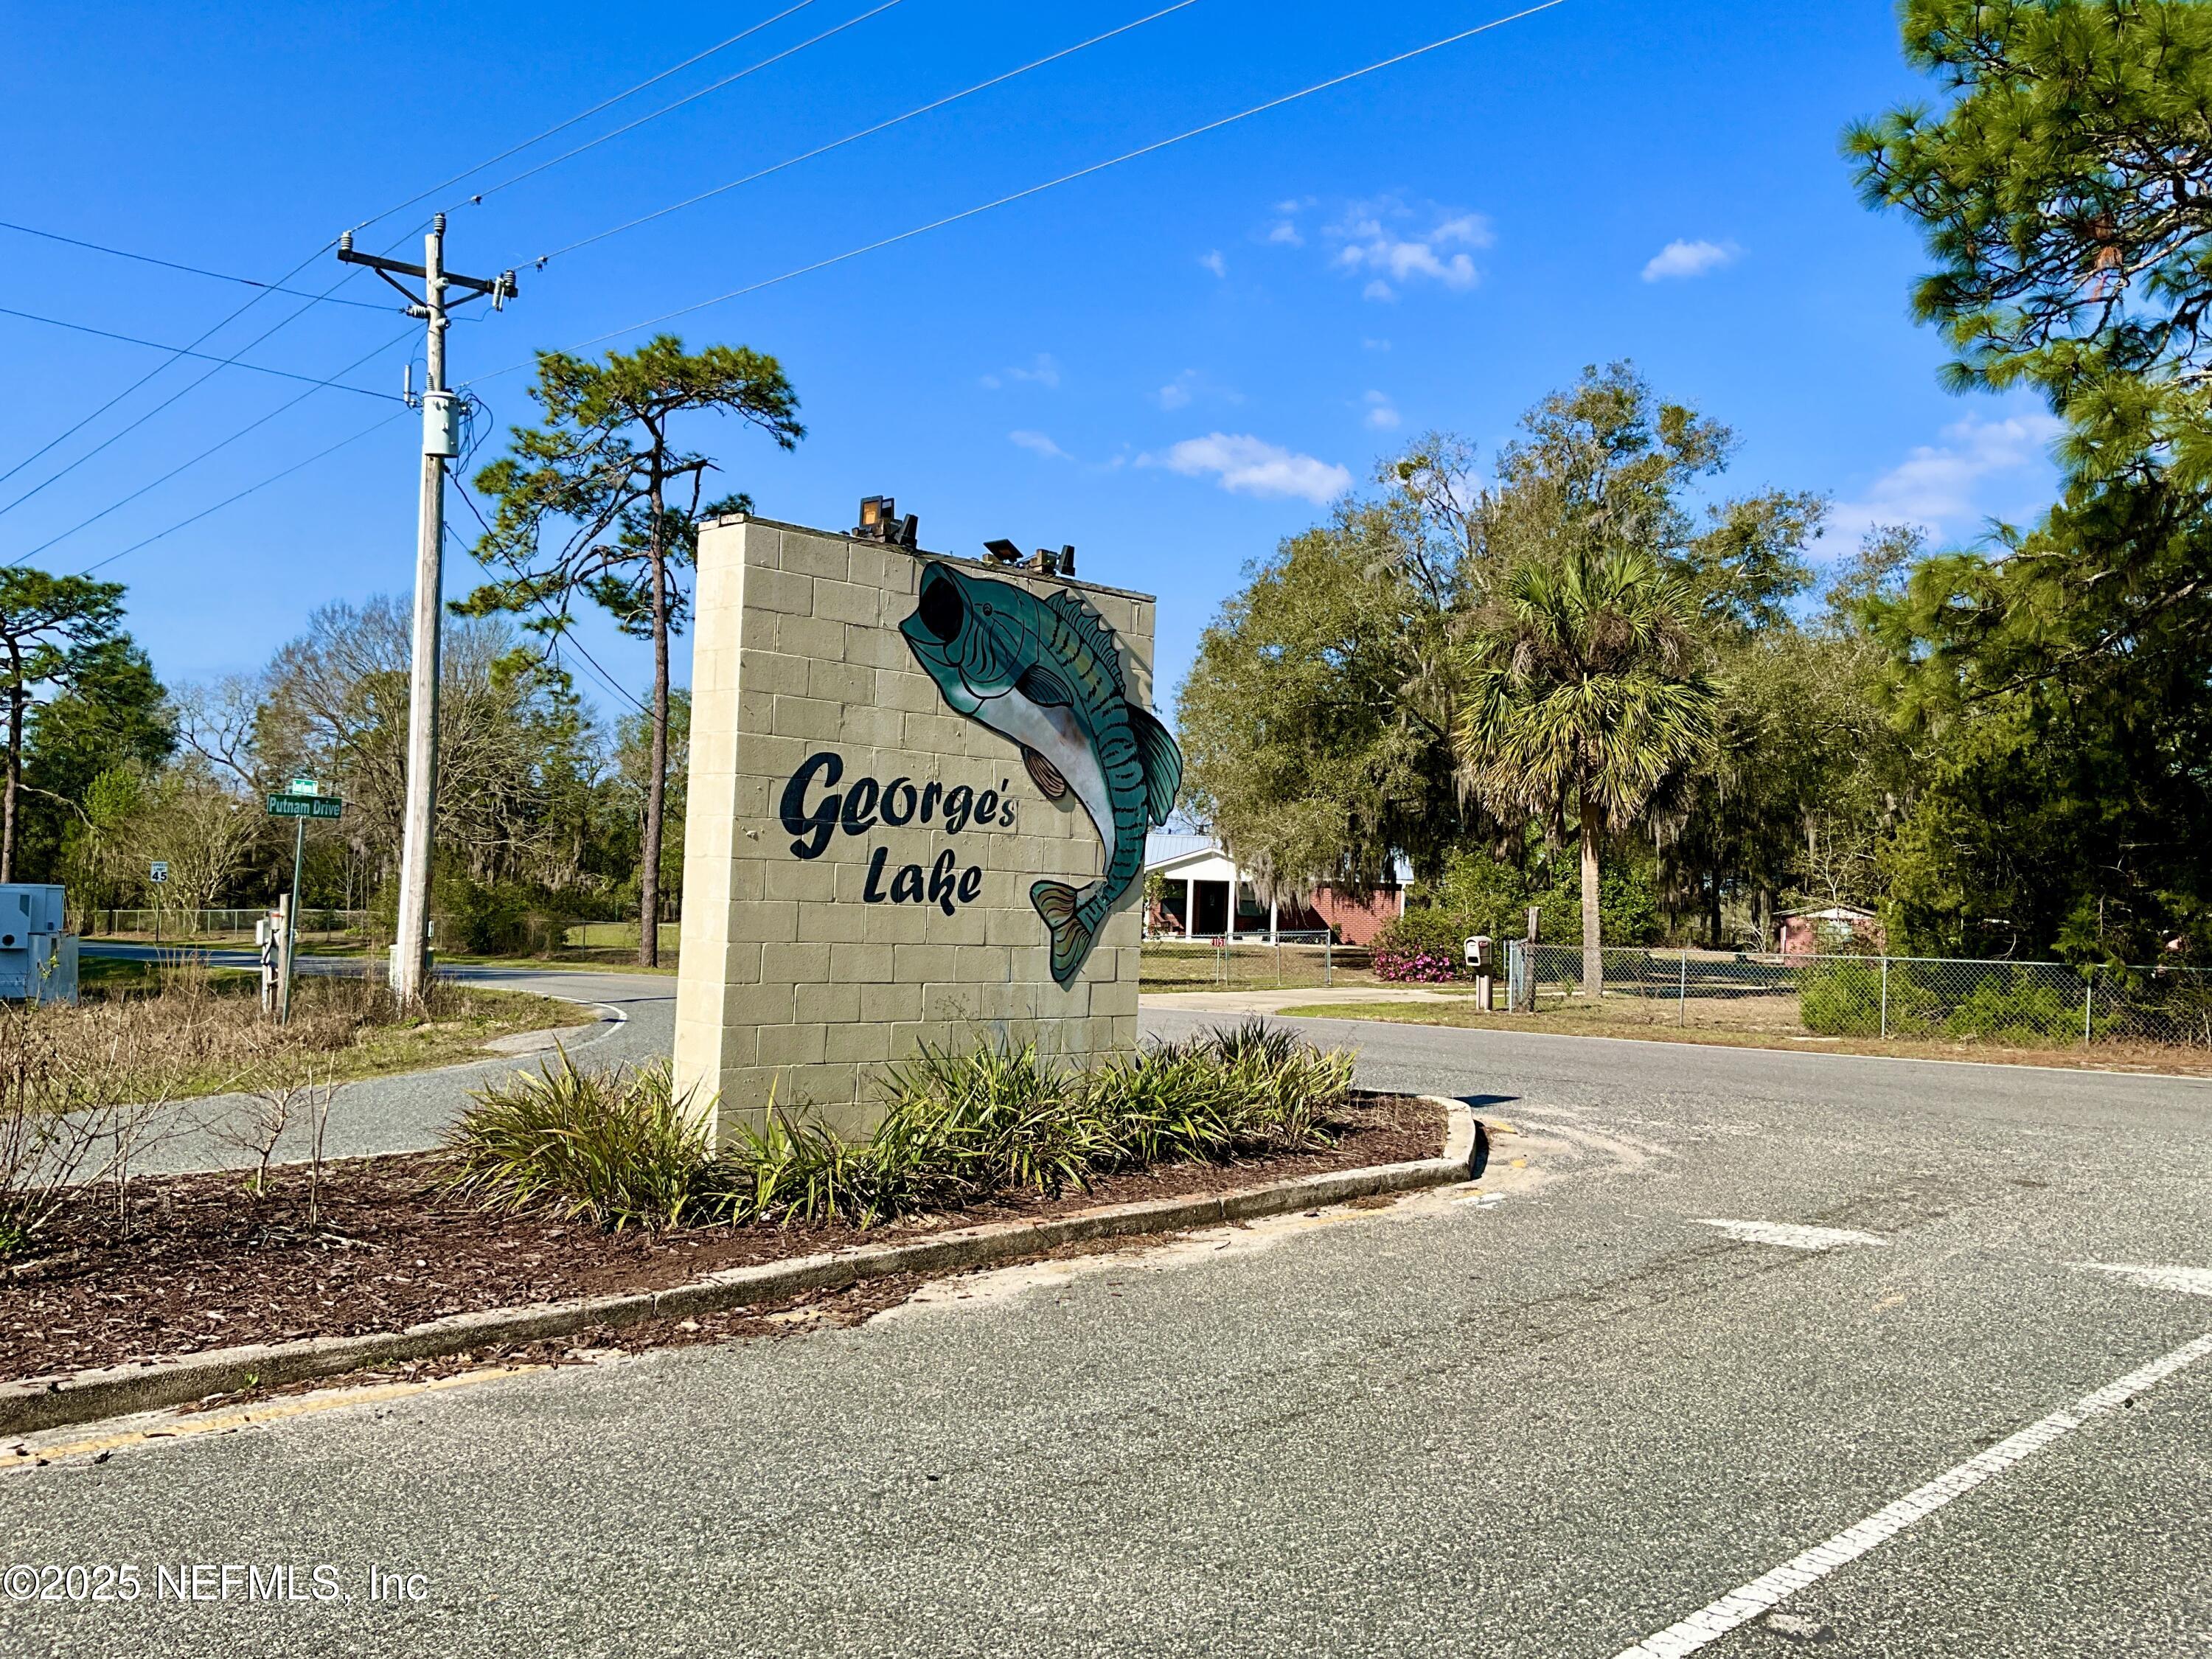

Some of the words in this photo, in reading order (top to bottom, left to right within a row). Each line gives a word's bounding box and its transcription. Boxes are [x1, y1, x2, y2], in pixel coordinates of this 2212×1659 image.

[268, 797, 310, 814] Putnam
[313, 799, 340, 815] Drive
[779, 751, 1018, 860] George's
[152, 872, 167, 880] 45
[863, 846, 983, 917] Lake
[1214, 938, 1225, 947] 1151
